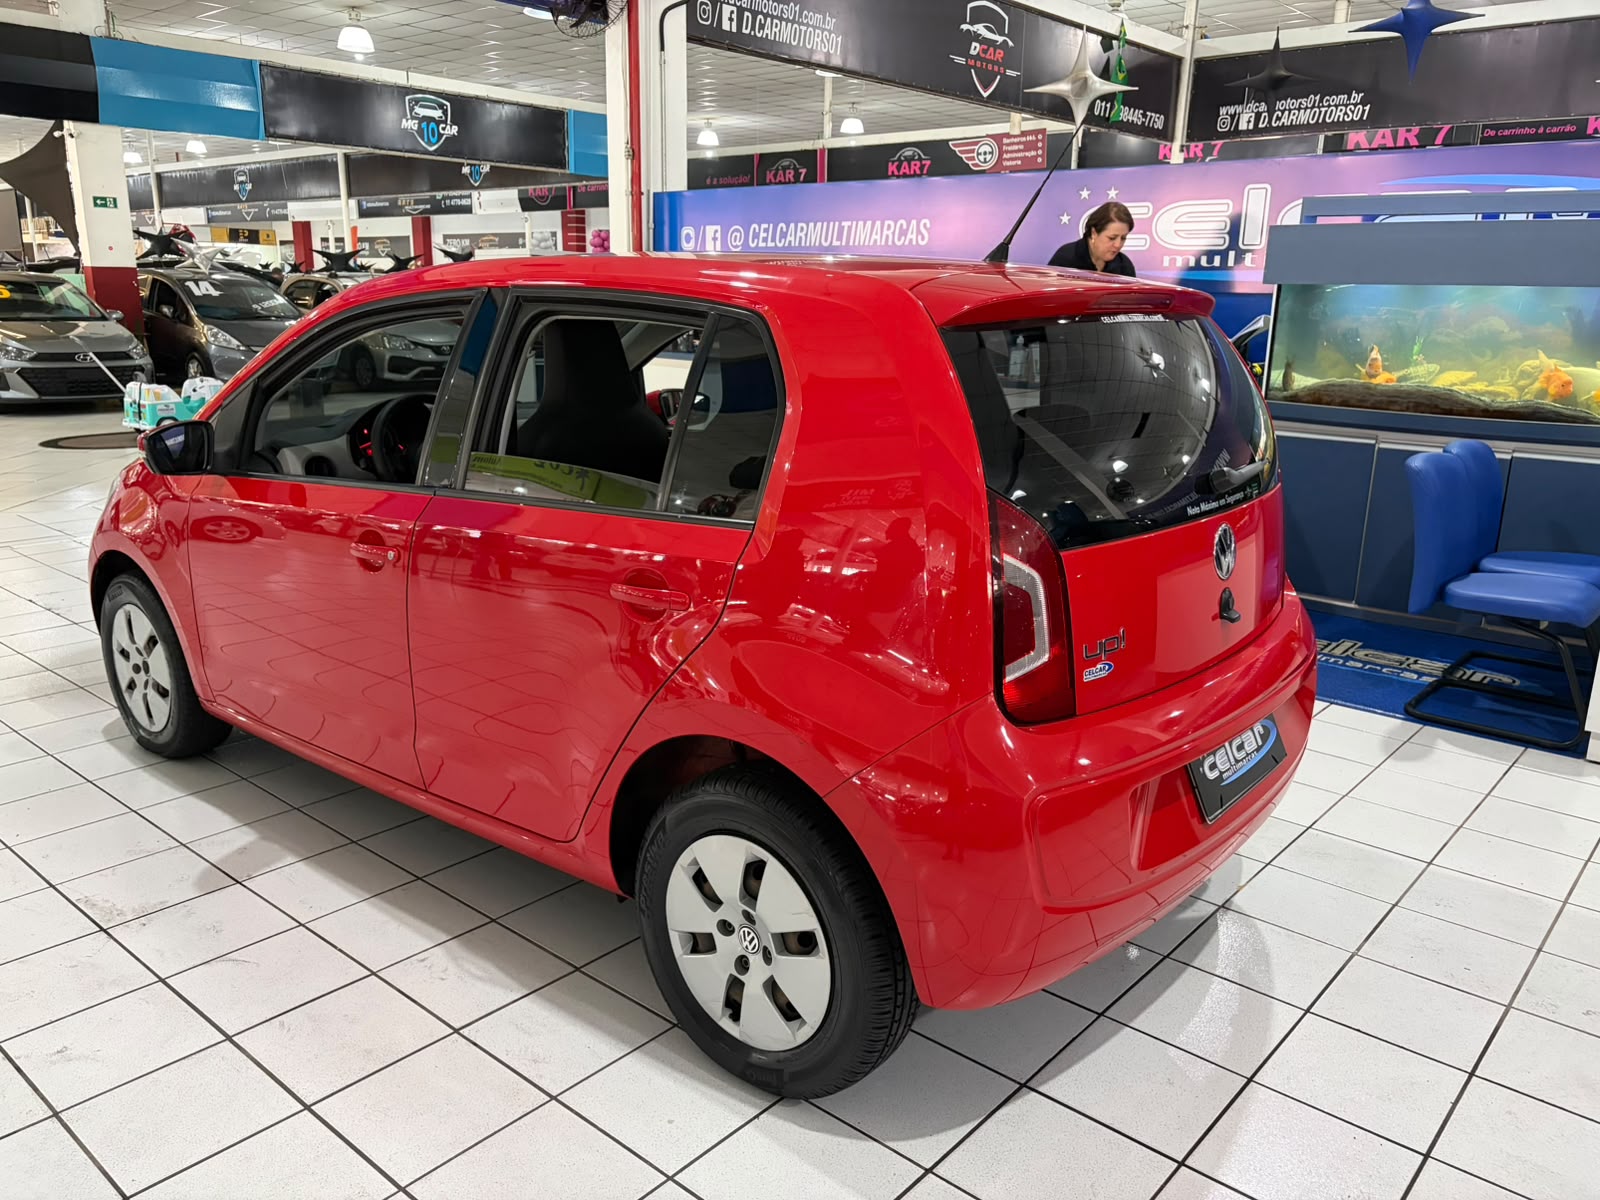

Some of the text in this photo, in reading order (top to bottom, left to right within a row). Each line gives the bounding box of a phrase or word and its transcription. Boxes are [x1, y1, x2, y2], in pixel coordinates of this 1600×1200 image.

[742, 11, 843, 55] D.CARMOTORS01
[967, 58, 1005, 74] MOTORS
[1094, 99, 1111, 118] 011
[401, 118, 459, 144] MG 10 CAR
[1346, 125, 1453, 150] KAR 7
[1483, 129, 1496, 137] De
[1497, 124, 1536, 136] carrinho
[1546, 123, 1577, 134] carrão
[1211, 141, 1225, 157] 7
[766, 168, 808, 183] KAR 7
[1078, 184, 1272, 250] cel
[749, 219, 931, 248] CELCARMULTIMARCAS
[1163, 250, 1259, 268] mult
[1083, 627, 1126, 661] up!
[1084, 665, 1108, 677] CELCAR
[1203, 721, 1265, 781] celcar
